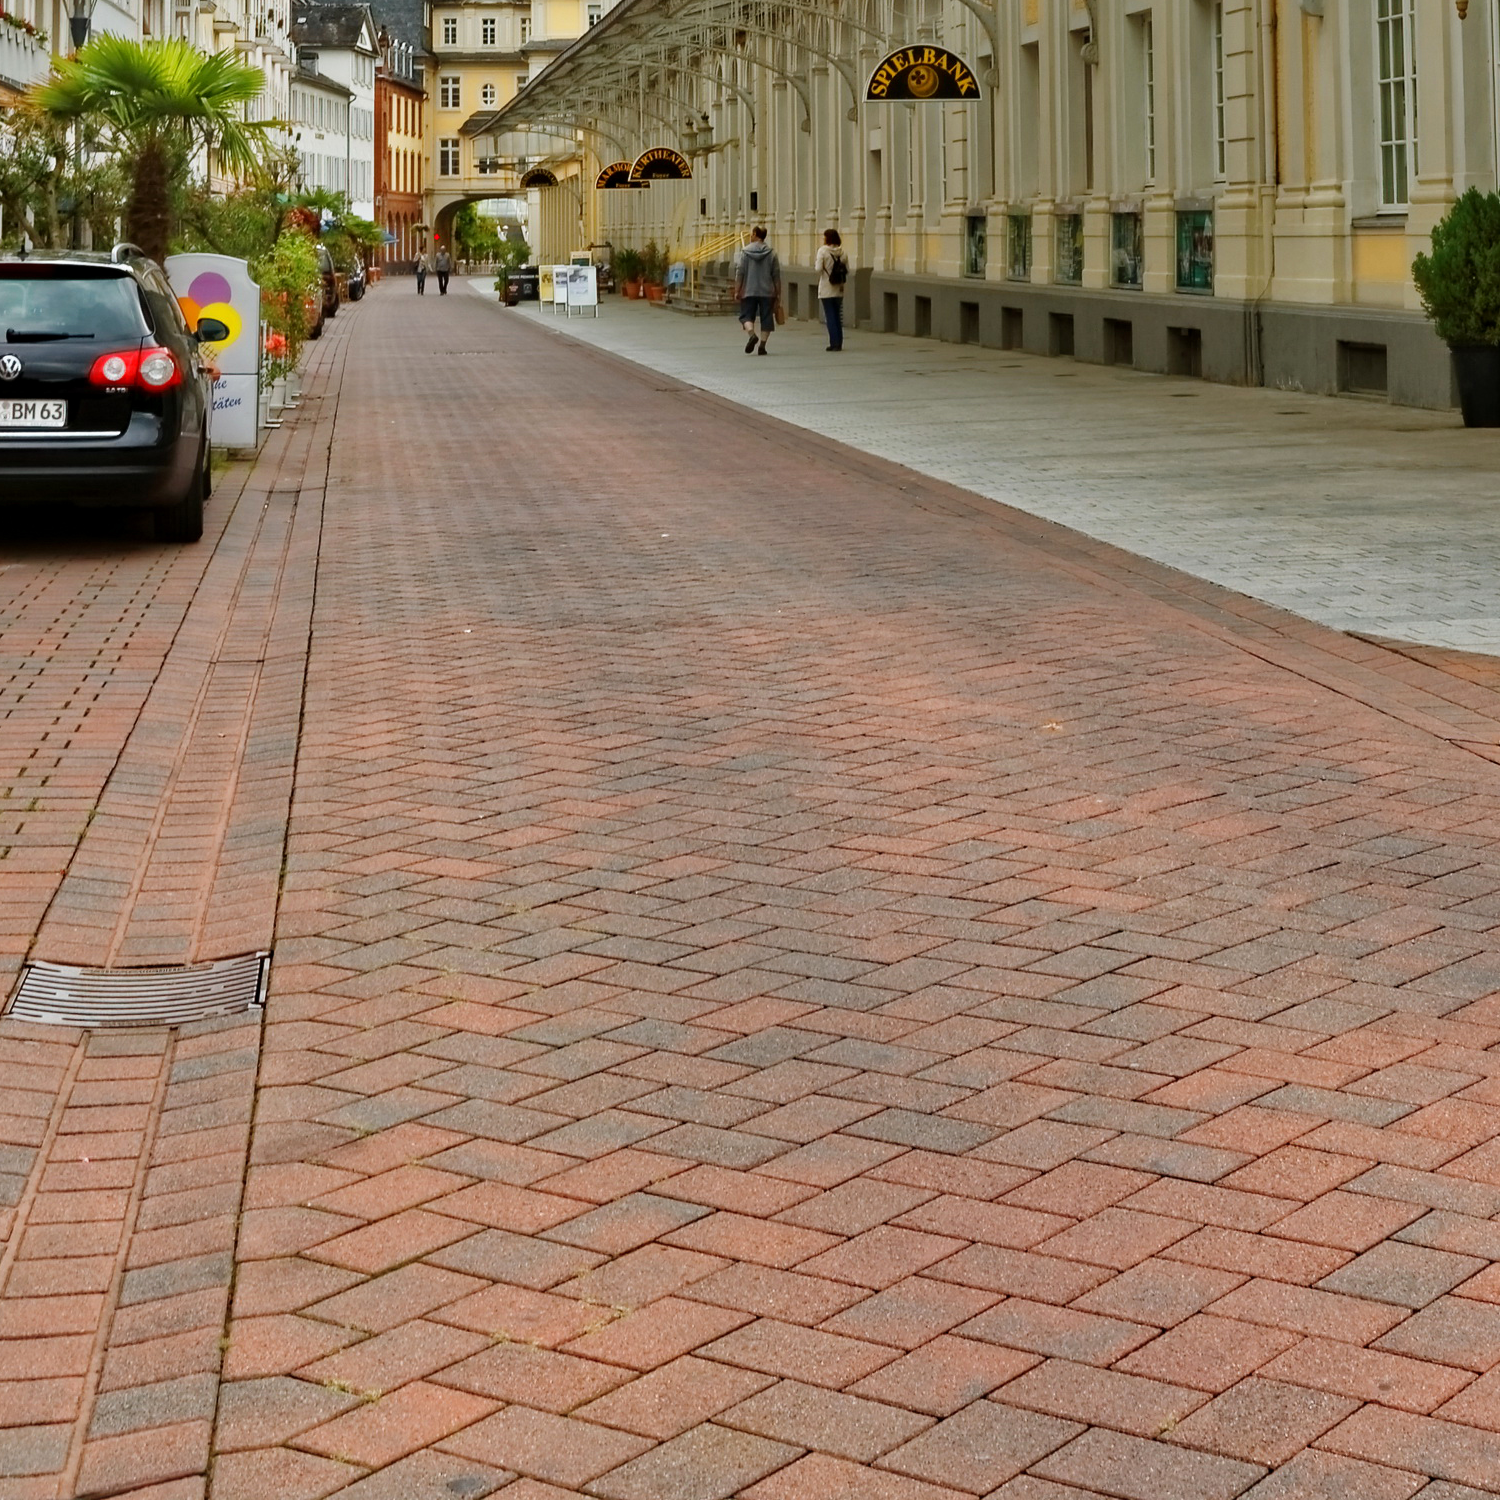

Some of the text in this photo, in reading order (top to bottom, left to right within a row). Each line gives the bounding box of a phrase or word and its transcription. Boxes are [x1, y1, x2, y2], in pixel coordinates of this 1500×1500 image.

[871, 47, 976, 97] SPIELBANK
[632, 150, 690, 178] KURTHEATER
[12, 402, 36, 420] BM
[40, 402, 63, 420] 63
